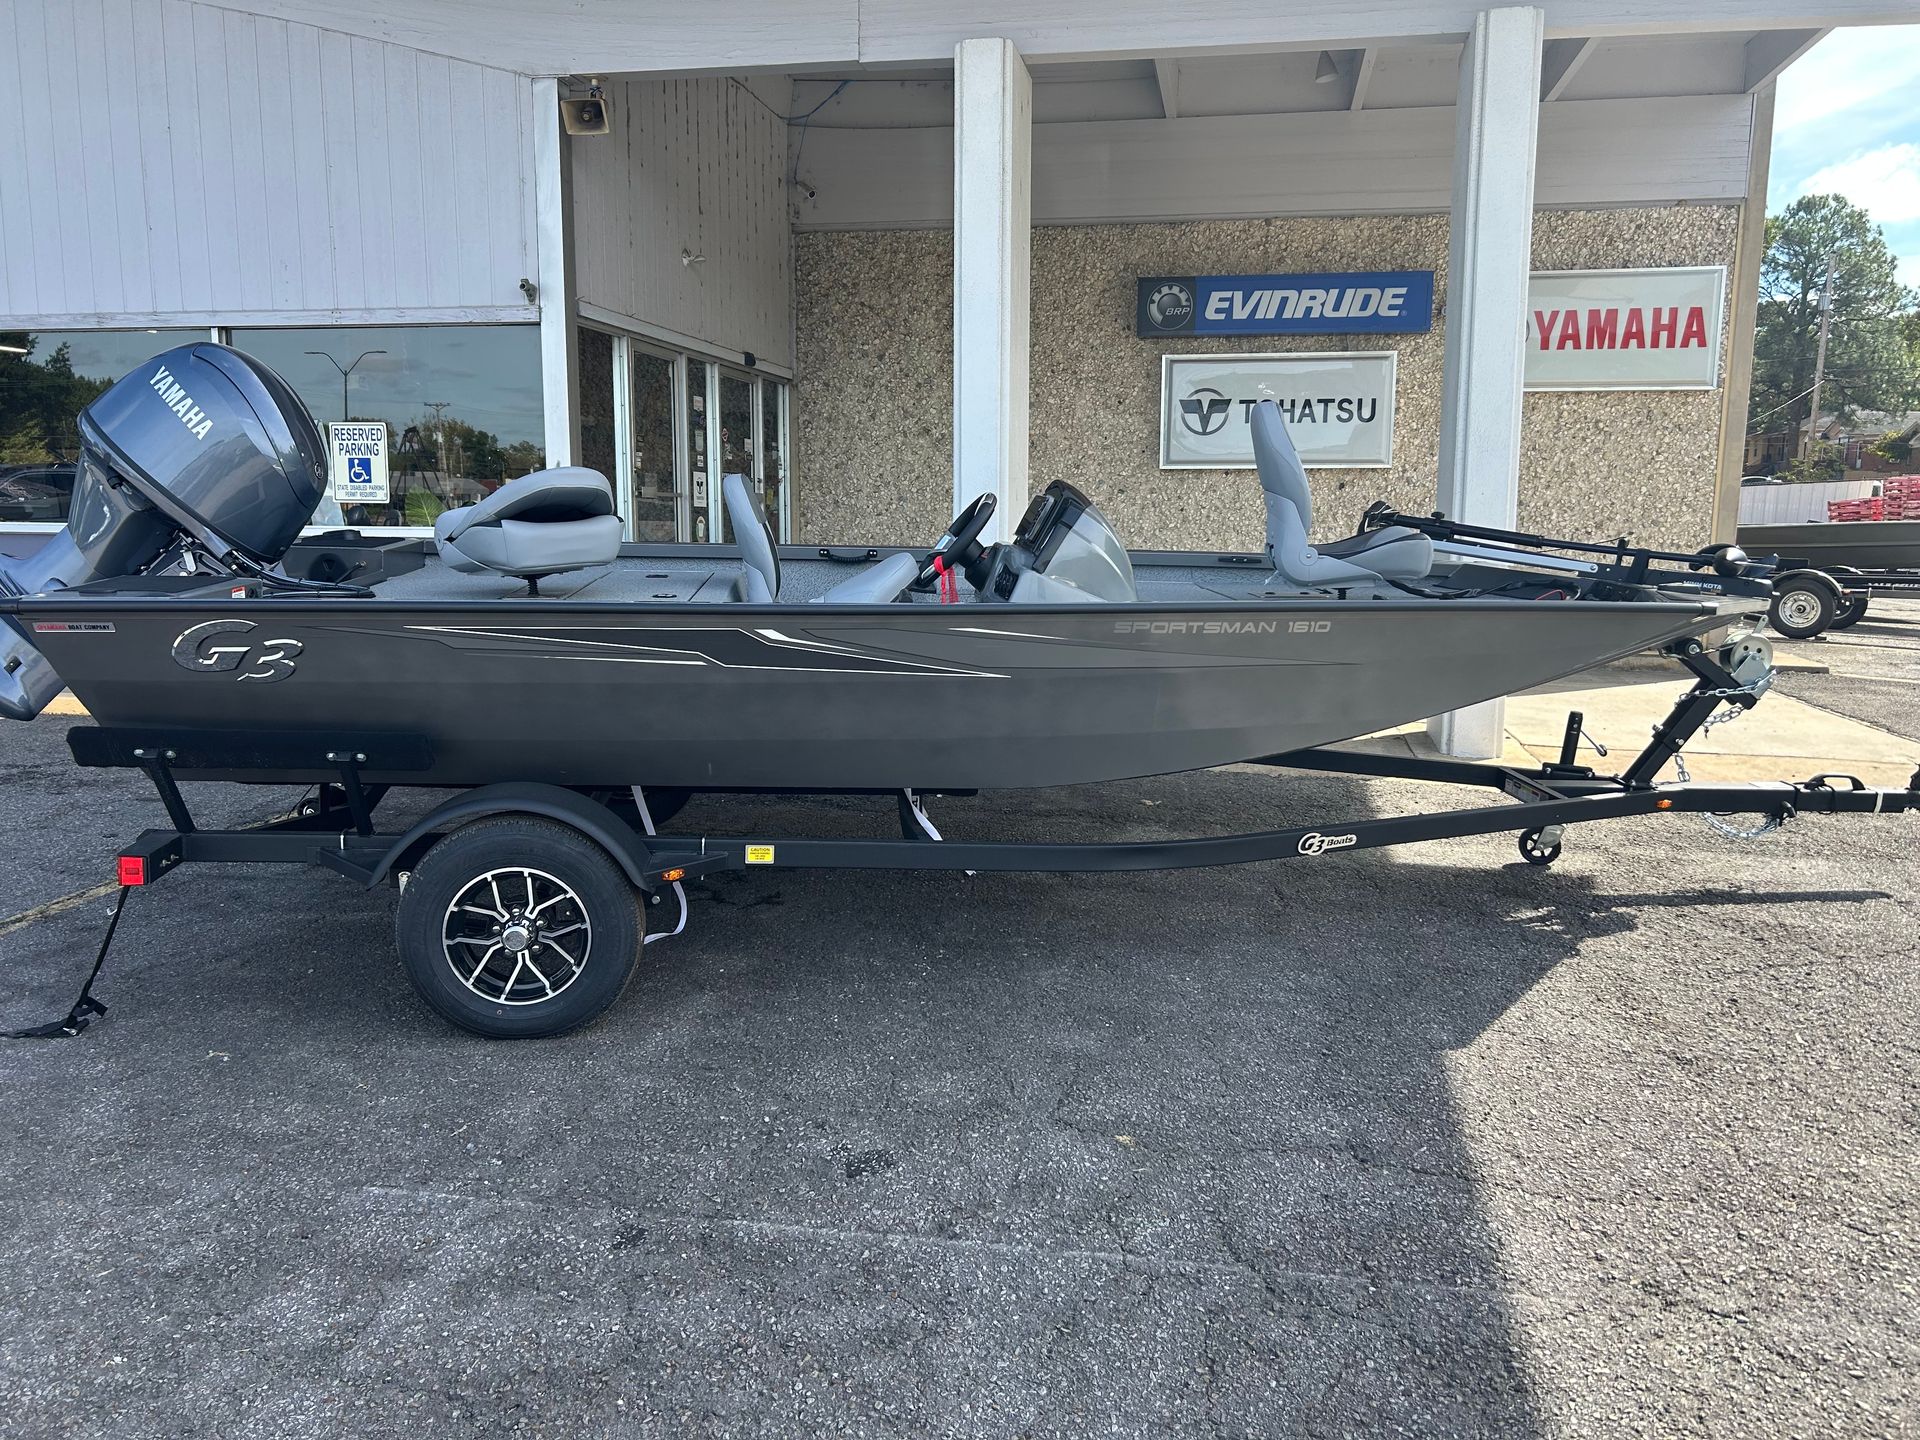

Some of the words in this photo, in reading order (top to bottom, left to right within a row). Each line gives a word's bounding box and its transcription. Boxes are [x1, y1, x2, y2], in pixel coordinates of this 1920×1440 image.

[1165, 307, 1191, 316] BRP
[1205, 287, 1408, 320] EVINRUDE
[1534, 306, 1707, 350] YAMAHA
[149, 365, 214, 441] YAMAHA
[1239, 397, 1377, 424] THATSU
[333, 428, 382, 441] RESERVED
[338, 443, 379, 456] PARKING
[1702, 582, 1722, 590] KOTA
[1113, 621, 1277, 634] SPORTSMAN
[1287, 621, 1332, 633] 1610
[171, 619, 303, 684] G3
[1299, 834, 1326, 854] G3
[1326, 836, 1354, 847] Boats
